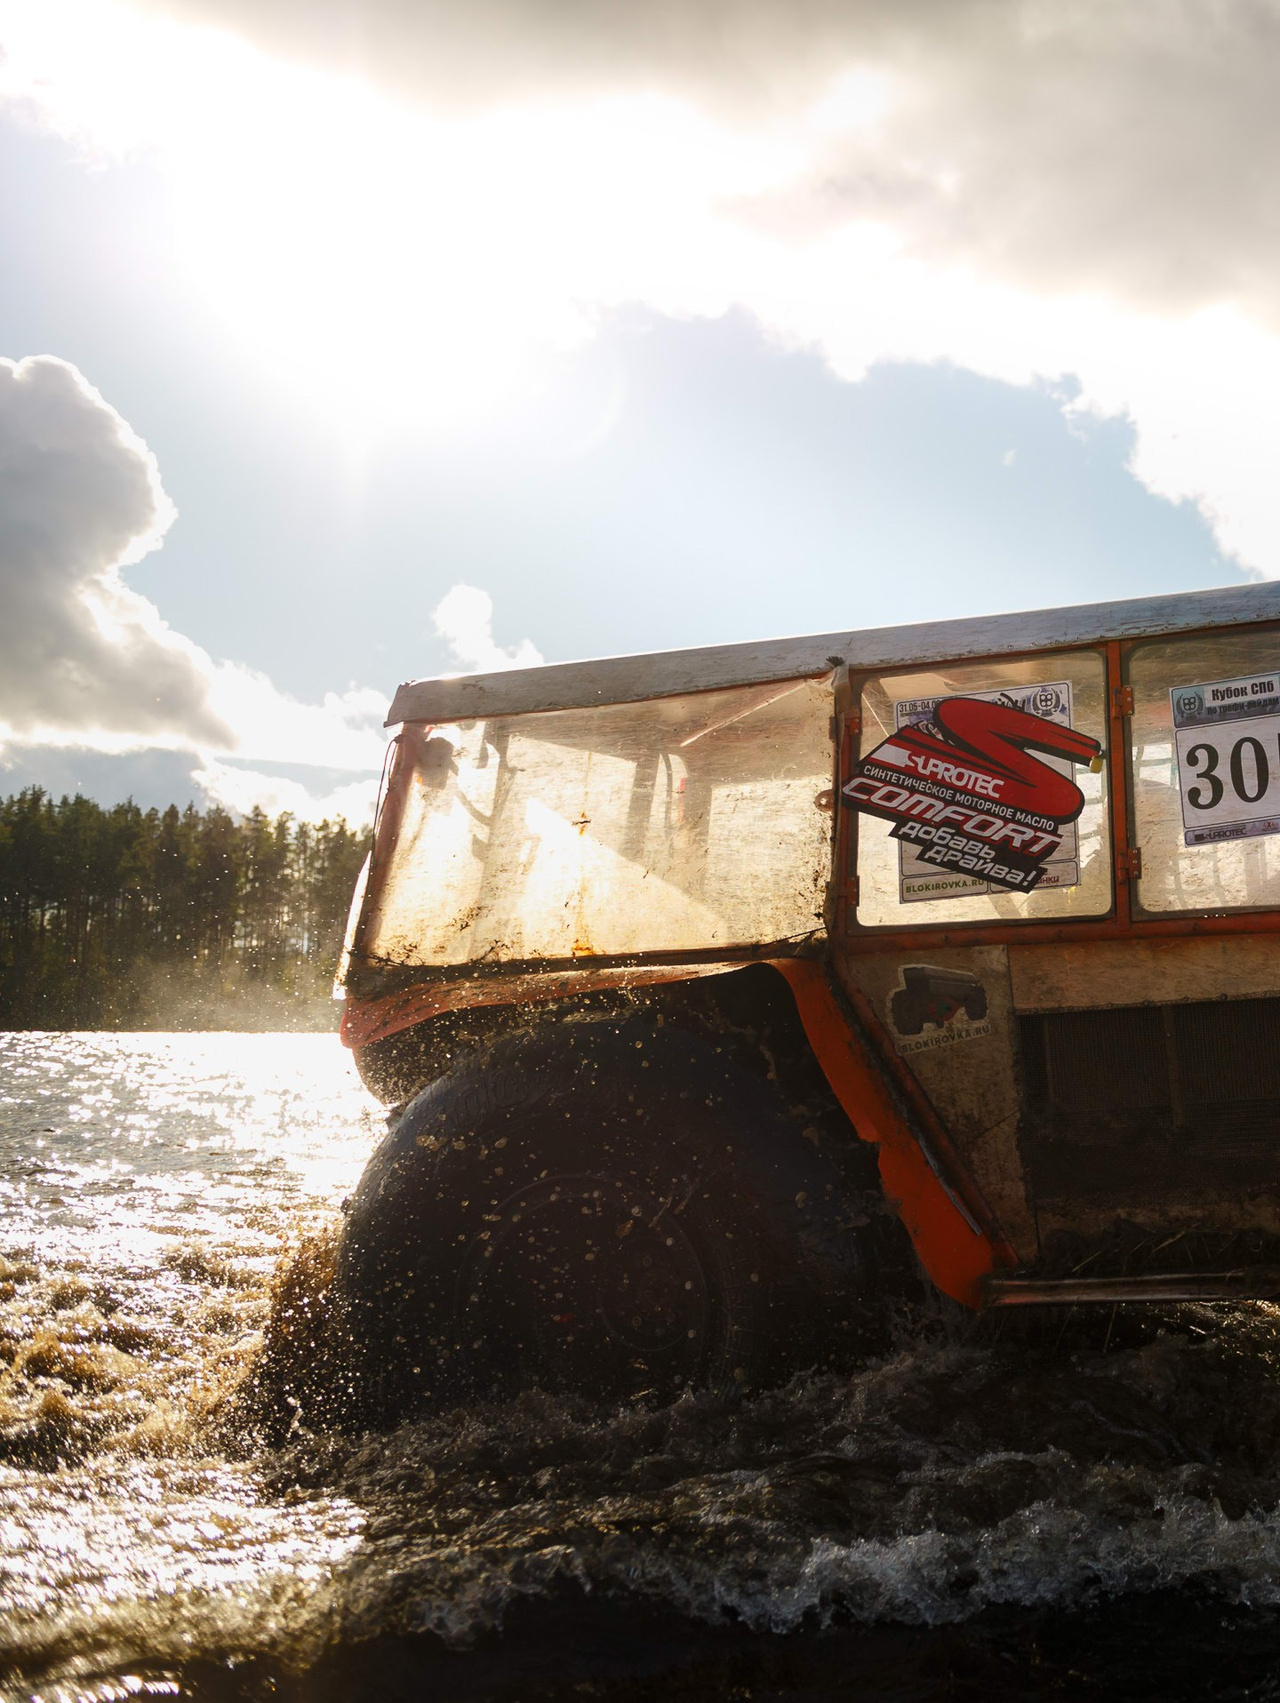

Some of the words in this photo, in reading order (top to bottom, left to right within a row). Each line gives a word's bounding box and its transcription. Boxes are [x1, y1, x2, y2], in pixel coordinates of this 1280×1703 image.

[1211, 686, 1248, 701] Кубок
[1250, 680, 1275, 695] СПб
[906, 750, 1005, 798] SUPROTEC
[843, 777, 1064, 853] COMFORT
[864, 765, 953, 800] СИНТЕТИЧЕСКОЕ
[954, 792, 1015, 819] МОТОРНОЕ
[1015, 811, 1055, 831] МАСЛО
[898, 821, 996, 859] добавь
[905, 879, 985, 893] BLOKIROVKA.RU
[924, 846, 1037, 887] драйва!
[901, 1024, 990, 1053] BLOKIROVKA.RU
